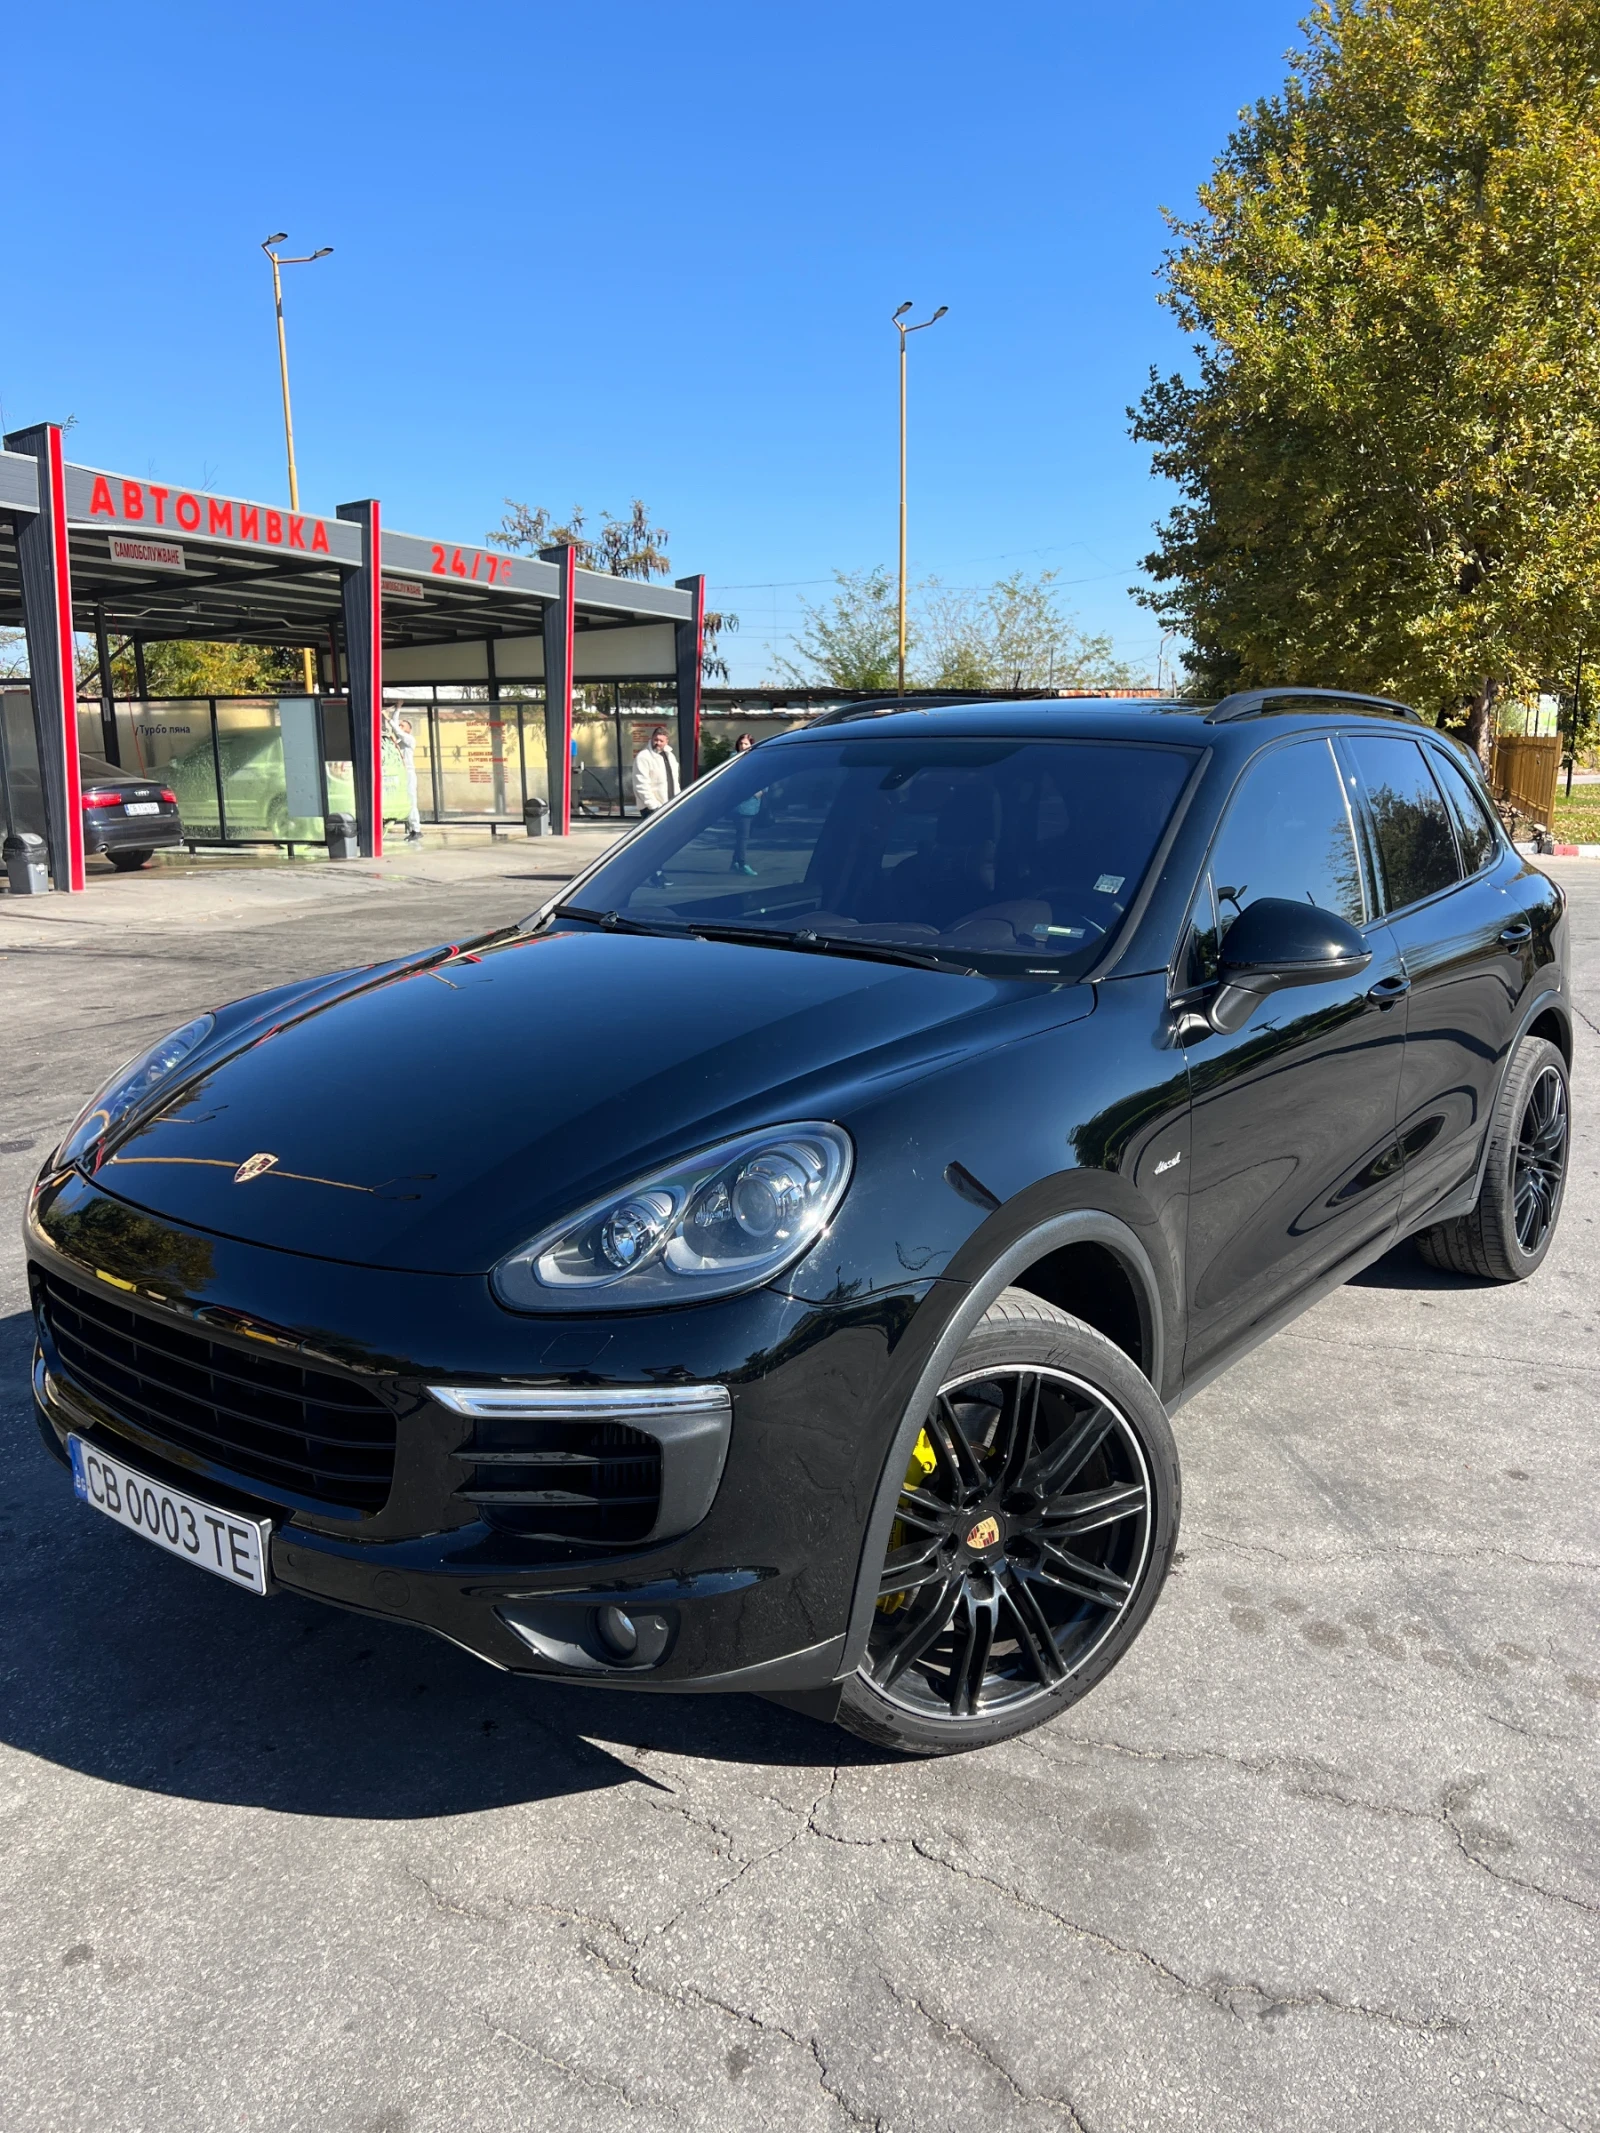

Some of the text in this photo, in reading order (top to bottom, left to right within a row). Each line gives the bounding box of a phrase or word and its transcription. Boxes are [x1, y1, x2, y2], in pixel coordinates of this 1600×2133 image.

[89, 474, 330, 553] АВТОМИВКА
[114, 541, 181, 565] САМООБСЛУЖВАНЕ
[139, 724, 191, 736] Турбо пяна
[75, 1475, 87, 1491] BG
